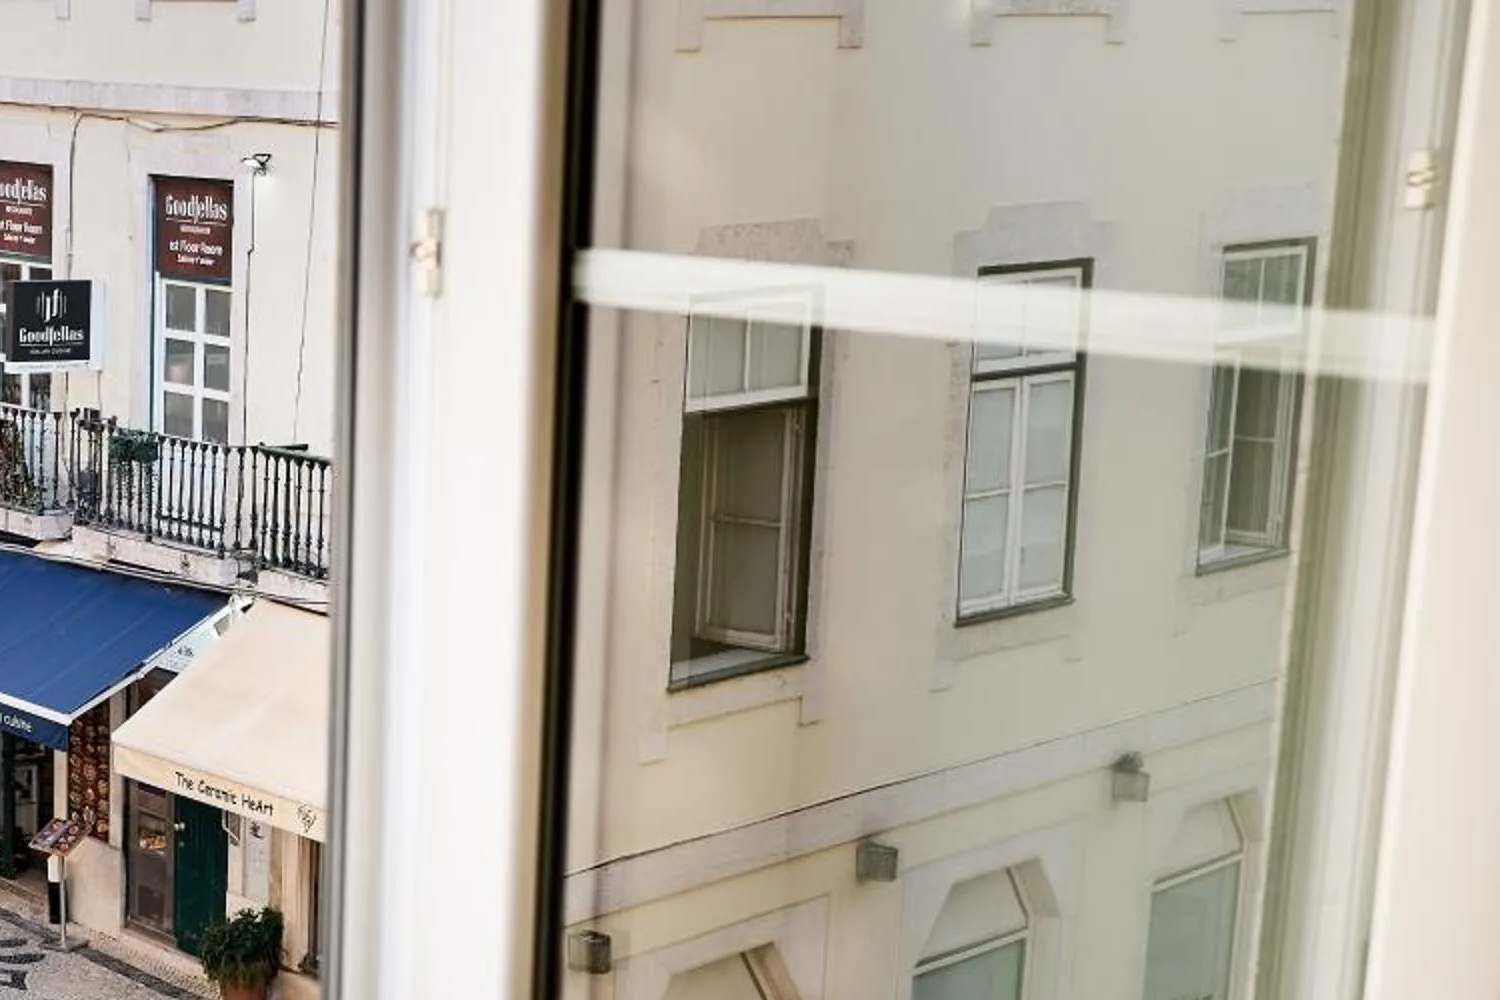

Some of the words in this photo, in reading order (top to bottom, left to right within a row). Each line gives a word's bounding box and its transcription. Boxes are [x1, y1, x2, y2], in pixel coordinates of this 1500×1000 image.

[165, 194, 228, 224] Goodfellas
[19, 325, 84, 347] Goodfellas
[3, 714, 33, 733] cuisine
[175, 771, 194, 791] The
[197, 779, 238, 805] Ceramic
